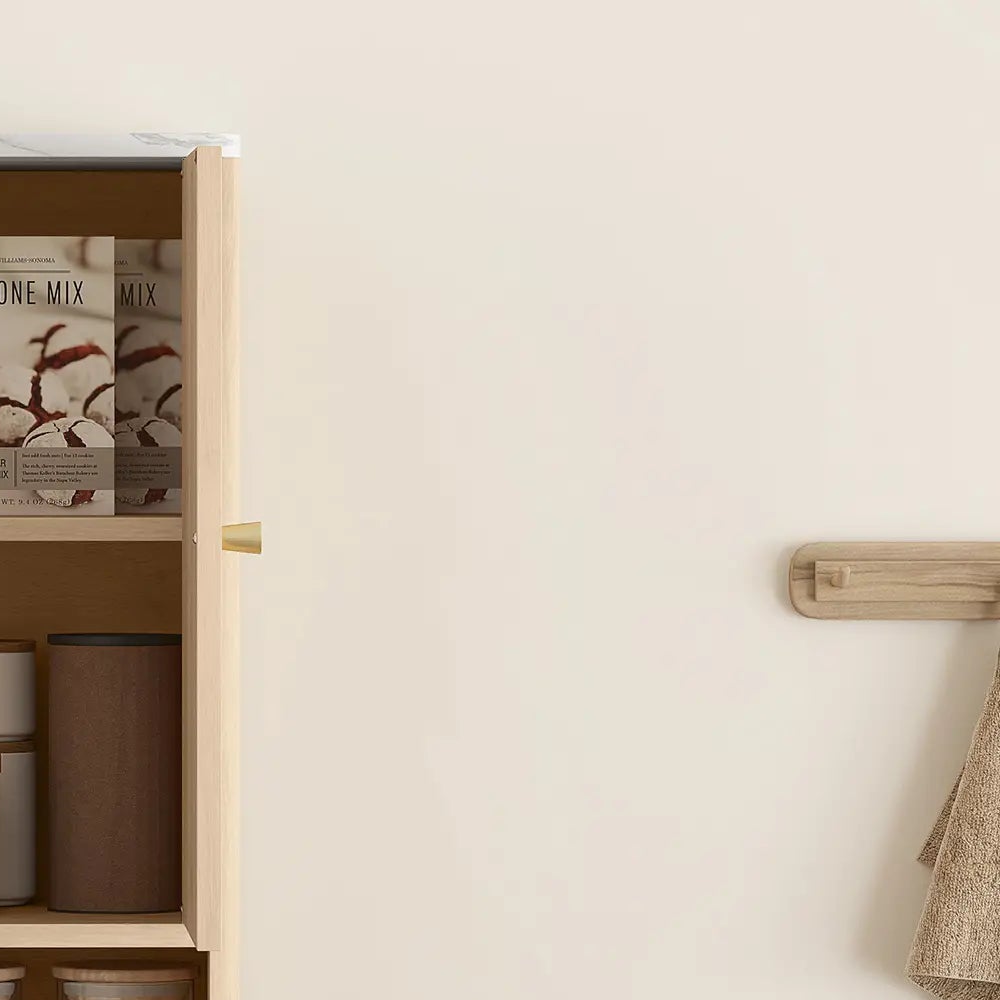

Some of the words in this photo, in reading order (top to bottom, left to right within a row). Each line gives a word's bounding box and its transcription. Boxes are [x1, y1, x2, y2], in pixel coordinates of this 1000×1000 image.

[47, 280, 84, 305] MIX
[120, 283, 156, 306] MIX
[18, 498, 31, 506] 9.4
[32, 498, 44, 506] OZ
